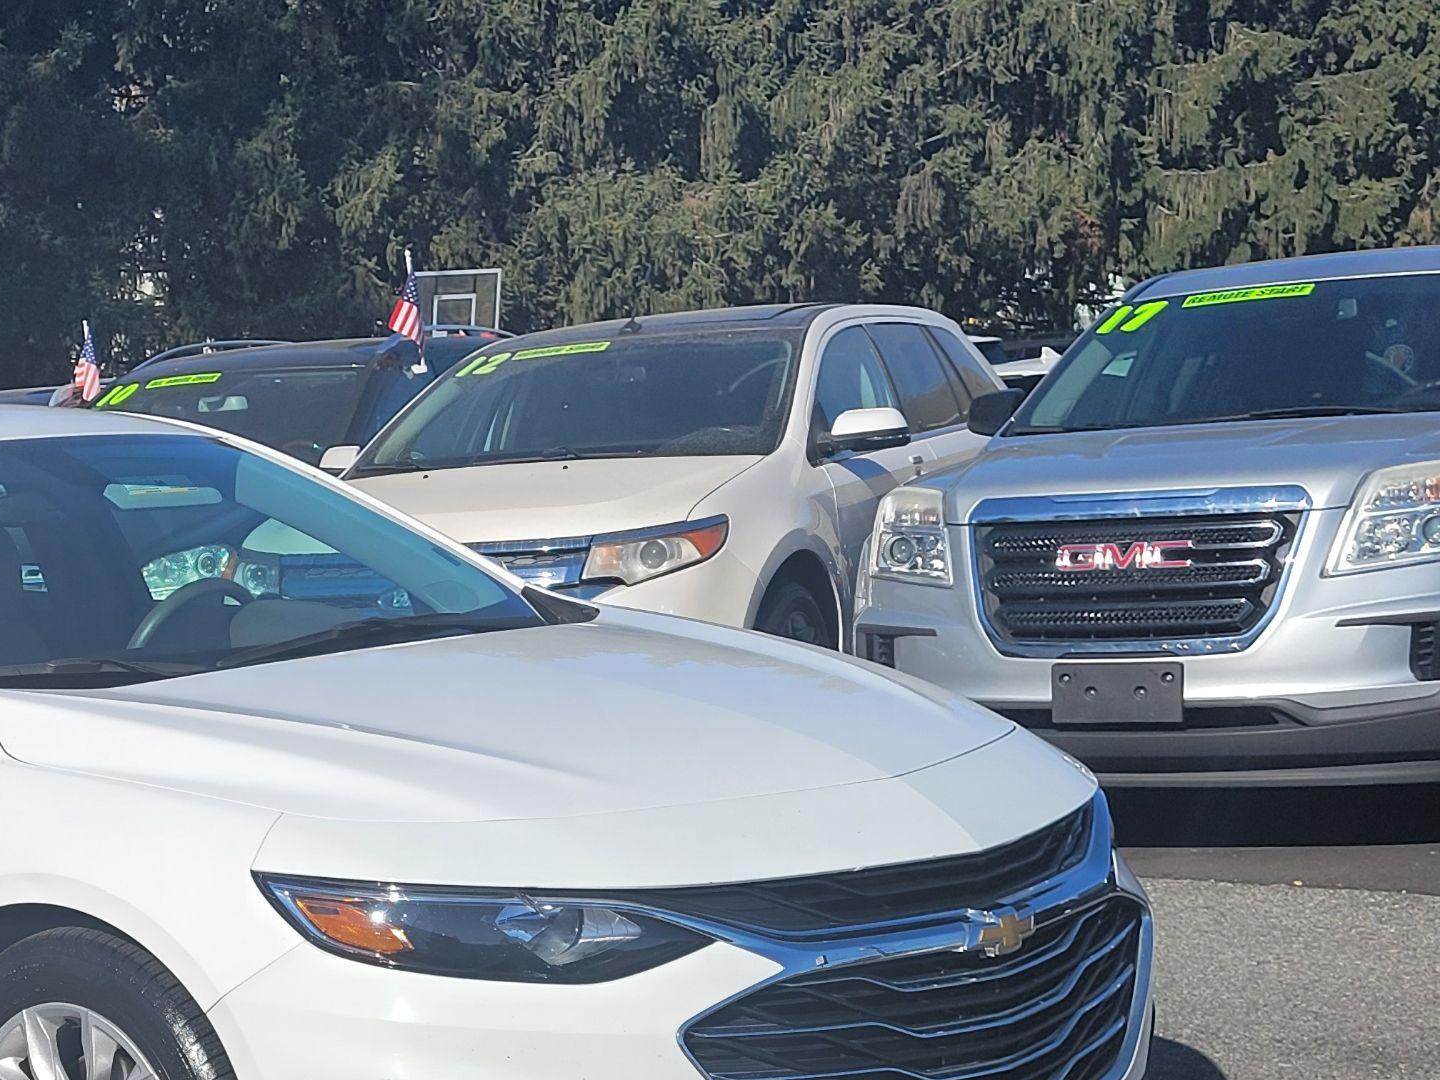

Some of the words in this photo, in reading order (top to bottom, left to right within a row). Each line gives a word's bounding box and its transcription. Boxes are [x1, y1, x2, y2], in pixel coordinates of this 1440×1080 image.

[1186, 289, 1255, 305] REMOTE
[1256, 285, 1308, 297] START
[1095, 300, 1169, 335] 17
[454, 352, 512, 378] 12
[95, 383, 140, 408] 10
[1055, 539, 1195, 572] GMC
